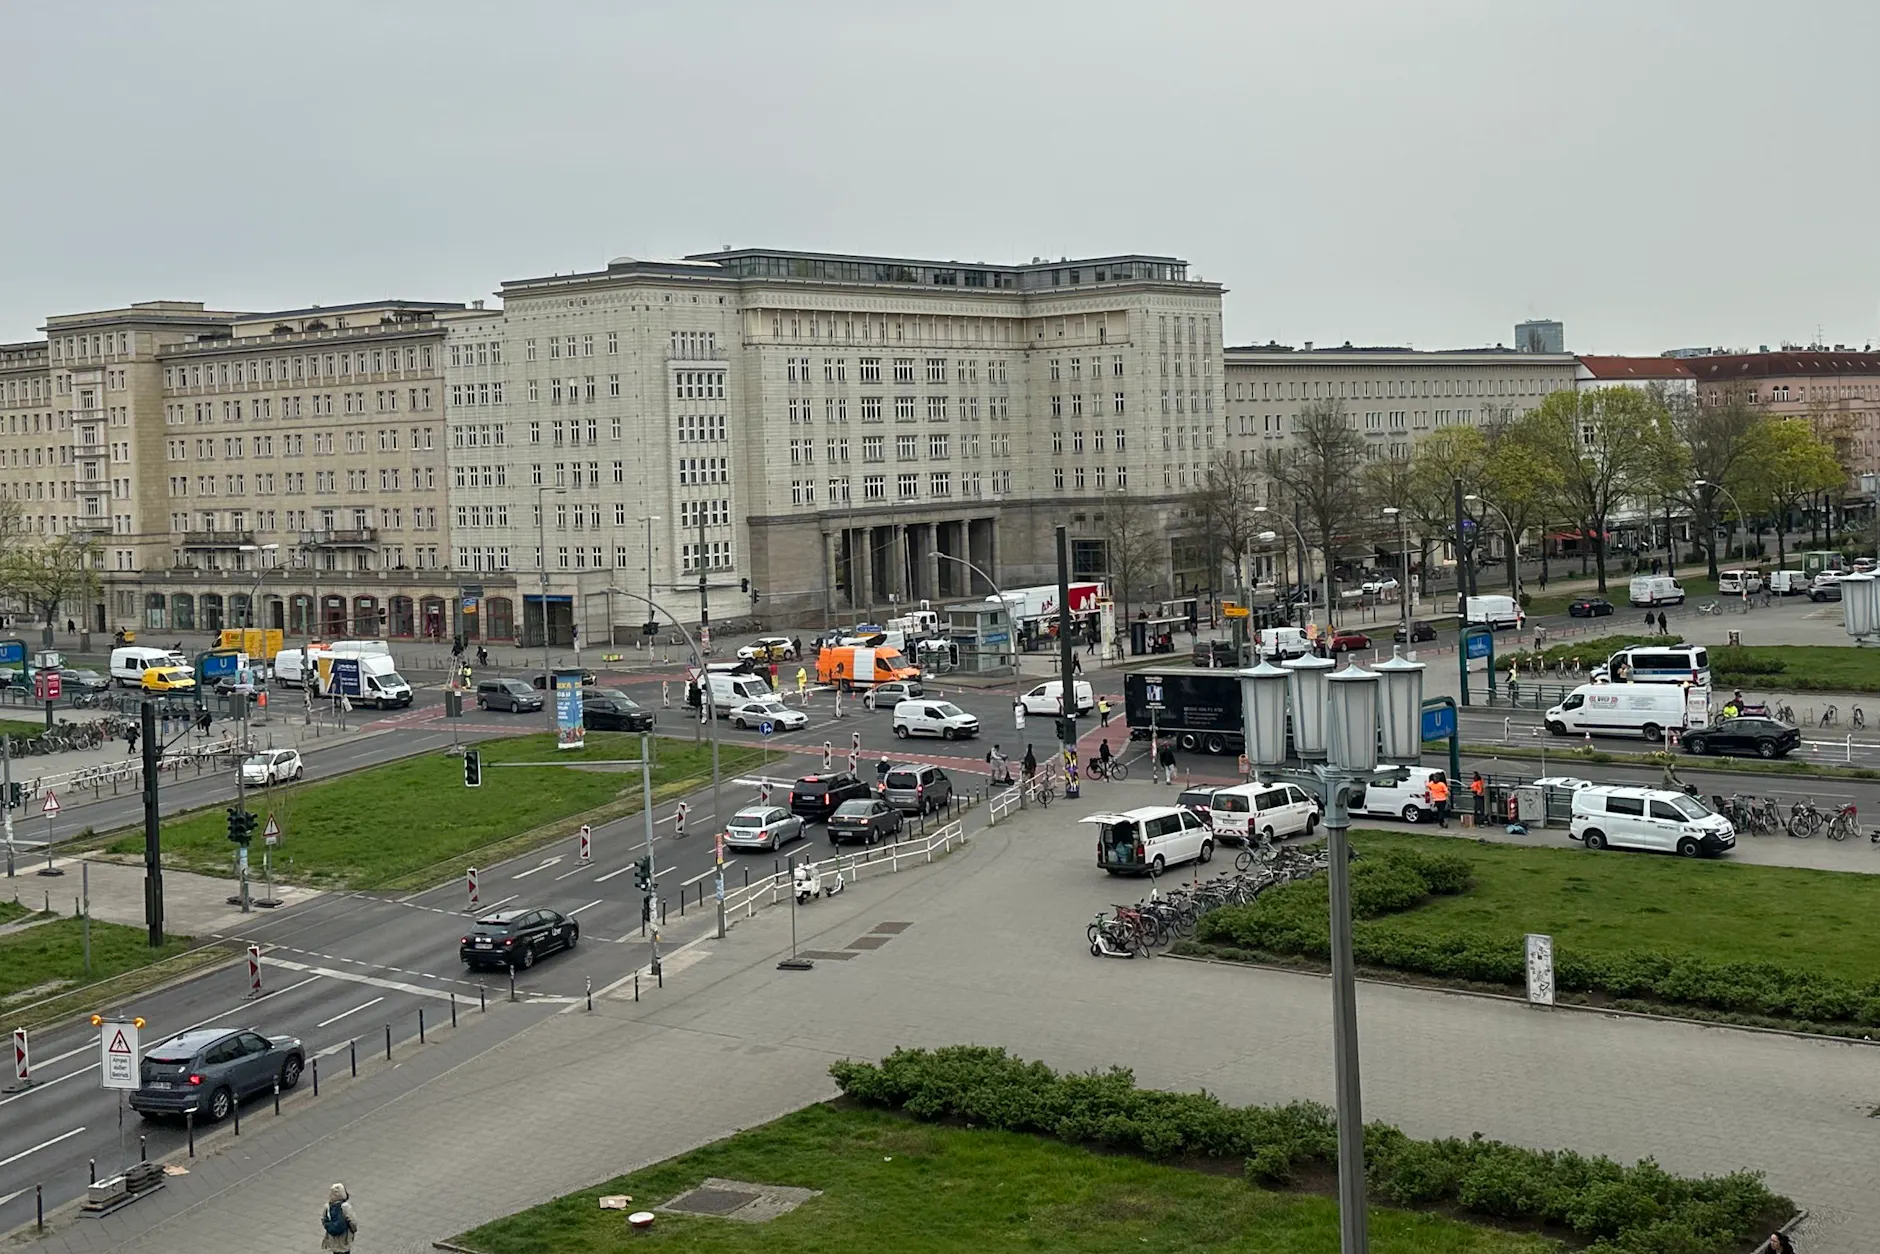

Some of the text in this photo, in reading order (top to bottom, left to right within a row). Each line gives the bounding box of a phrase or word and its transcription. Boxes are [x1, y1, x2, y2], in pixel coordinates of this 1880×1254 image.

[0, 648, 7, 657] U
[220, 658, 227, 668] U
[1435, 711, 1441, 726] U
